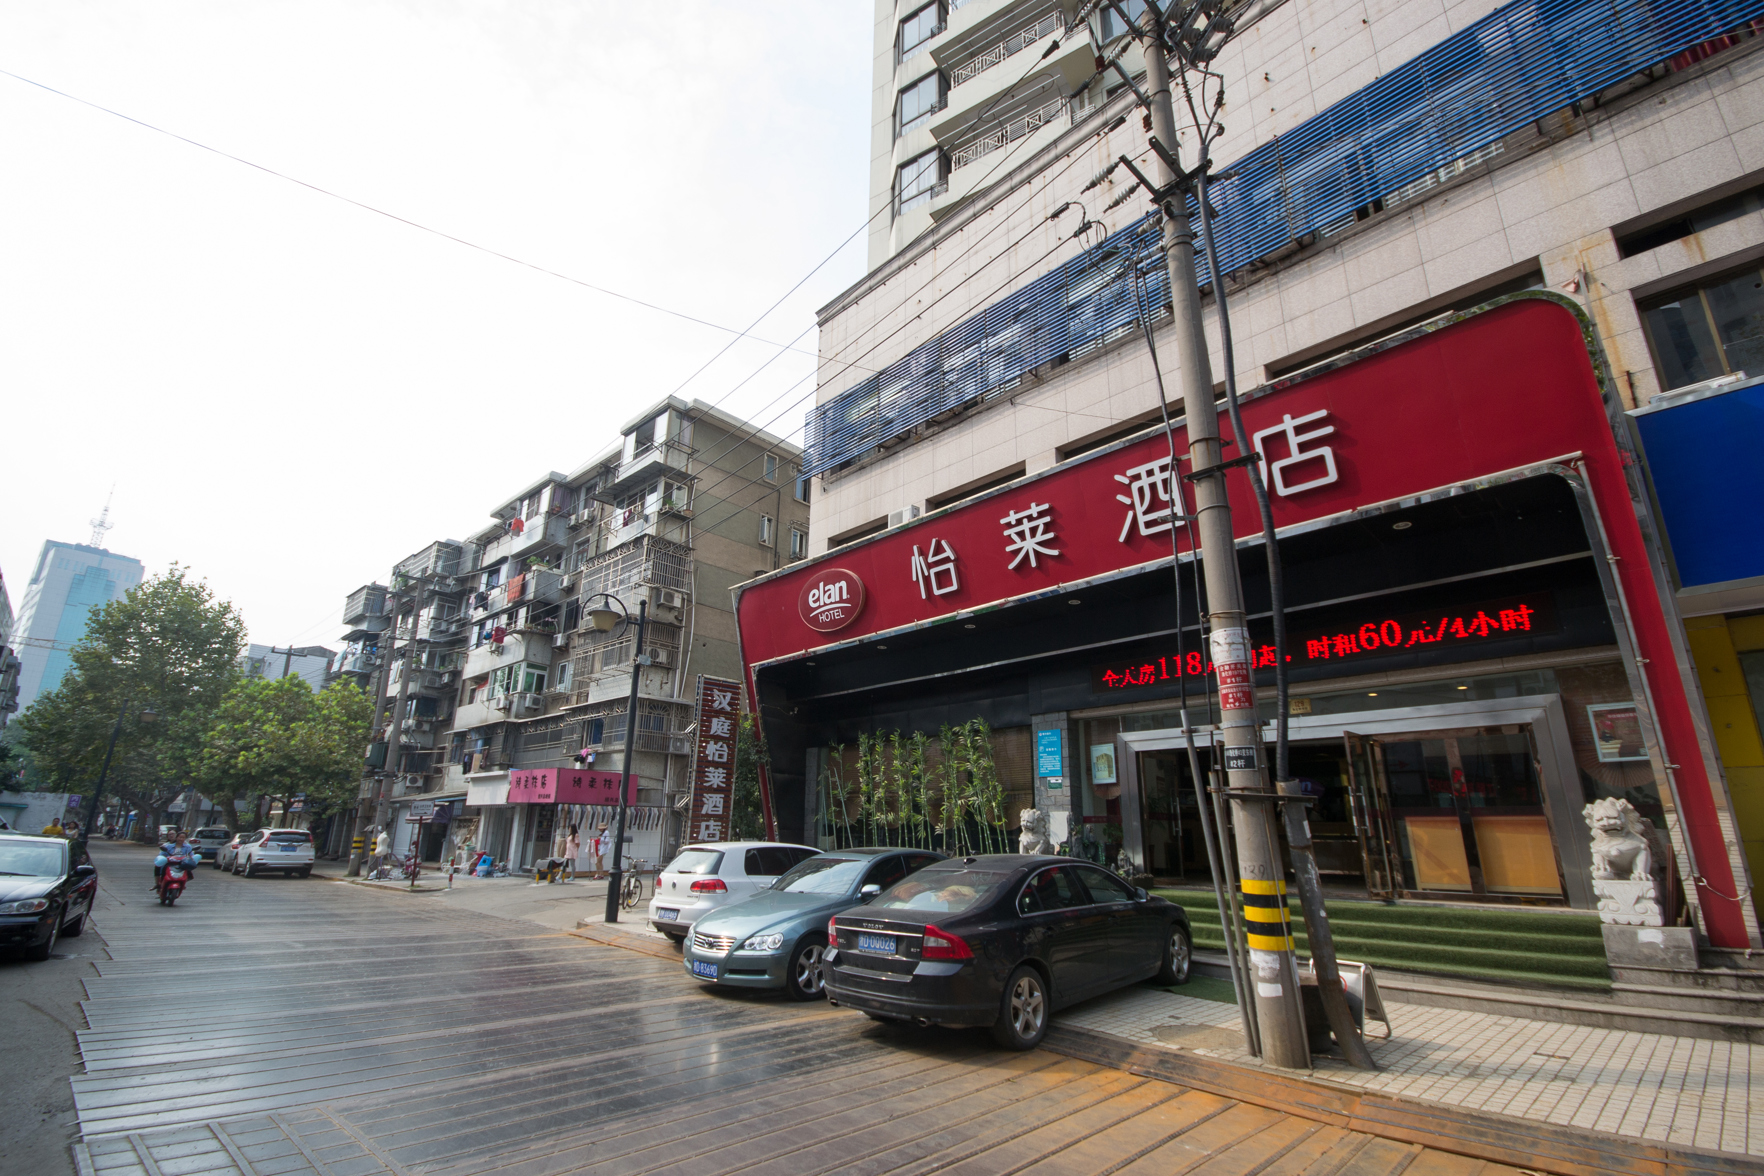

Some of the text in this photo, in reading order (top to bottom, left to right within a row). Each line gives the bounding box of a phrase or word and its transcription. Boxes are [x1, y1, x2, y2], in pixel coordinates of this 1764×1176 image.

[911, 408, 1338, 600] 怡莱酒店
[808, 580, 847, 608] elan
[818, 608, 845, 623] HOTEL
[698, 688, 733, 842] 汉庭怡莱酒店
